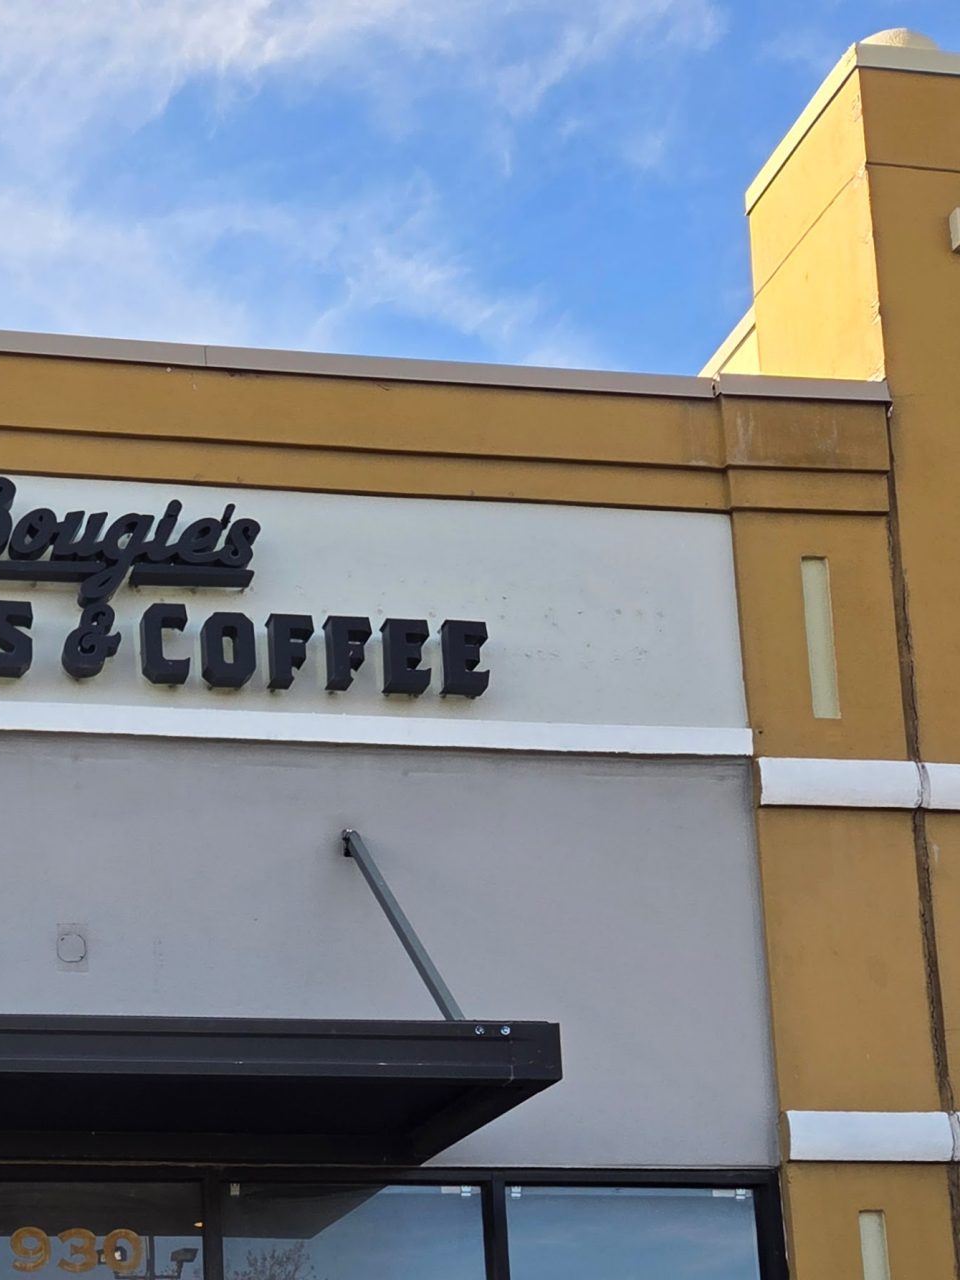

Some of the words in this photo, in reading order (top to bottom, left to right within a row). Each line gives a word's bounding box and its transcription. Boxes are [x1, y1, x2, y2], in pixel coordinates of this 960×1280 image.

[61, 602, 122, 680] &
[139, 602, 490, 699] COFFEE
[9, 1226, 146, 1274] 930
